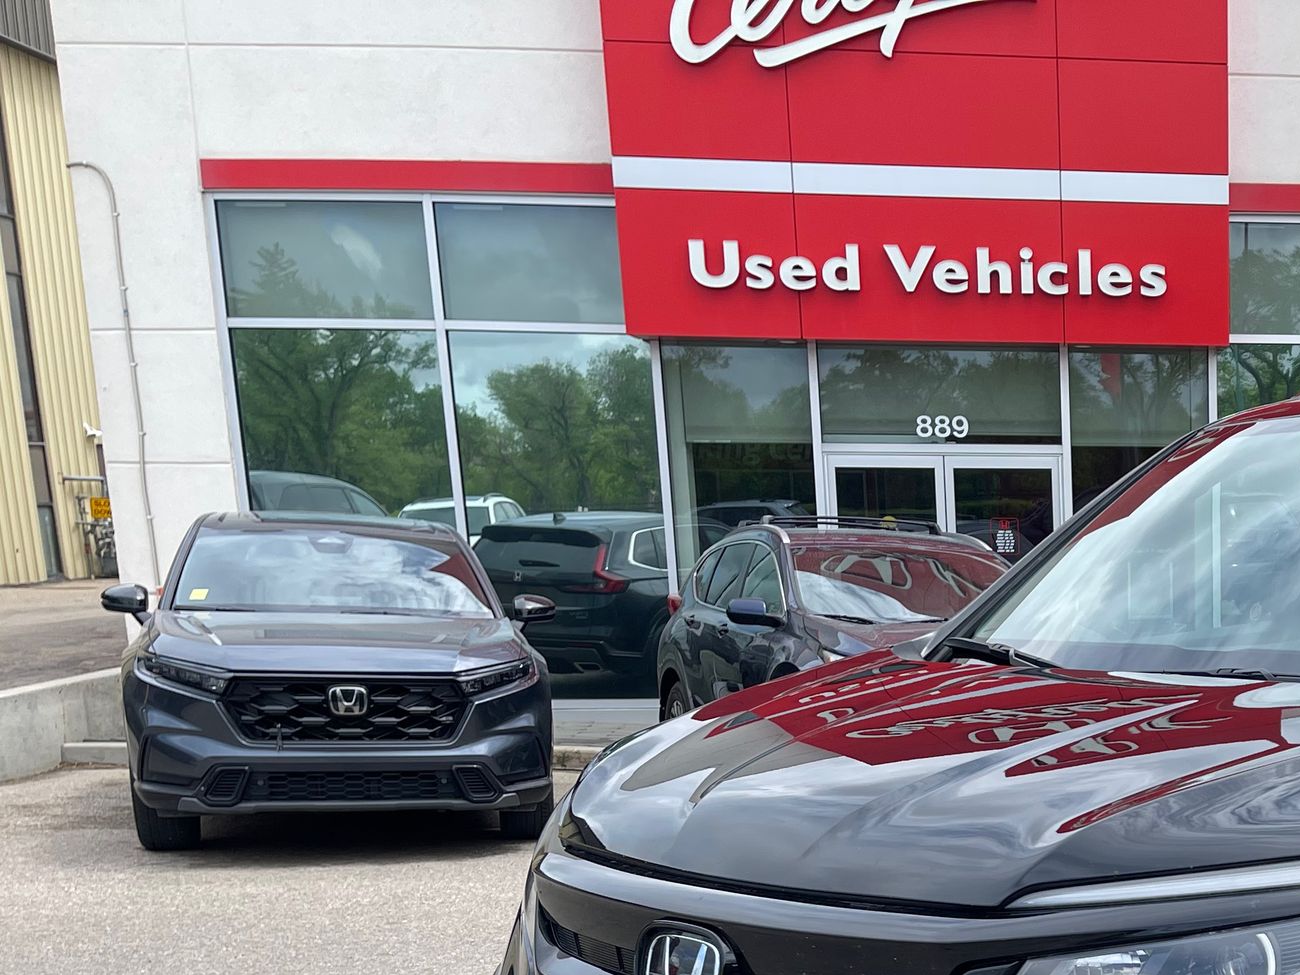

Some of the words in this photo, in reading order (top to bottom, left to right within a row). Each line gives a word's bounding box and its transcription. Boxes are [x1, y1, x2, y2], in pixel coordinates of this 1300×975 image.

[687, 238, 861, 292] Used
[883, 244, 1168, 297] Vehicles
[916, 414, 969, 438] 889
